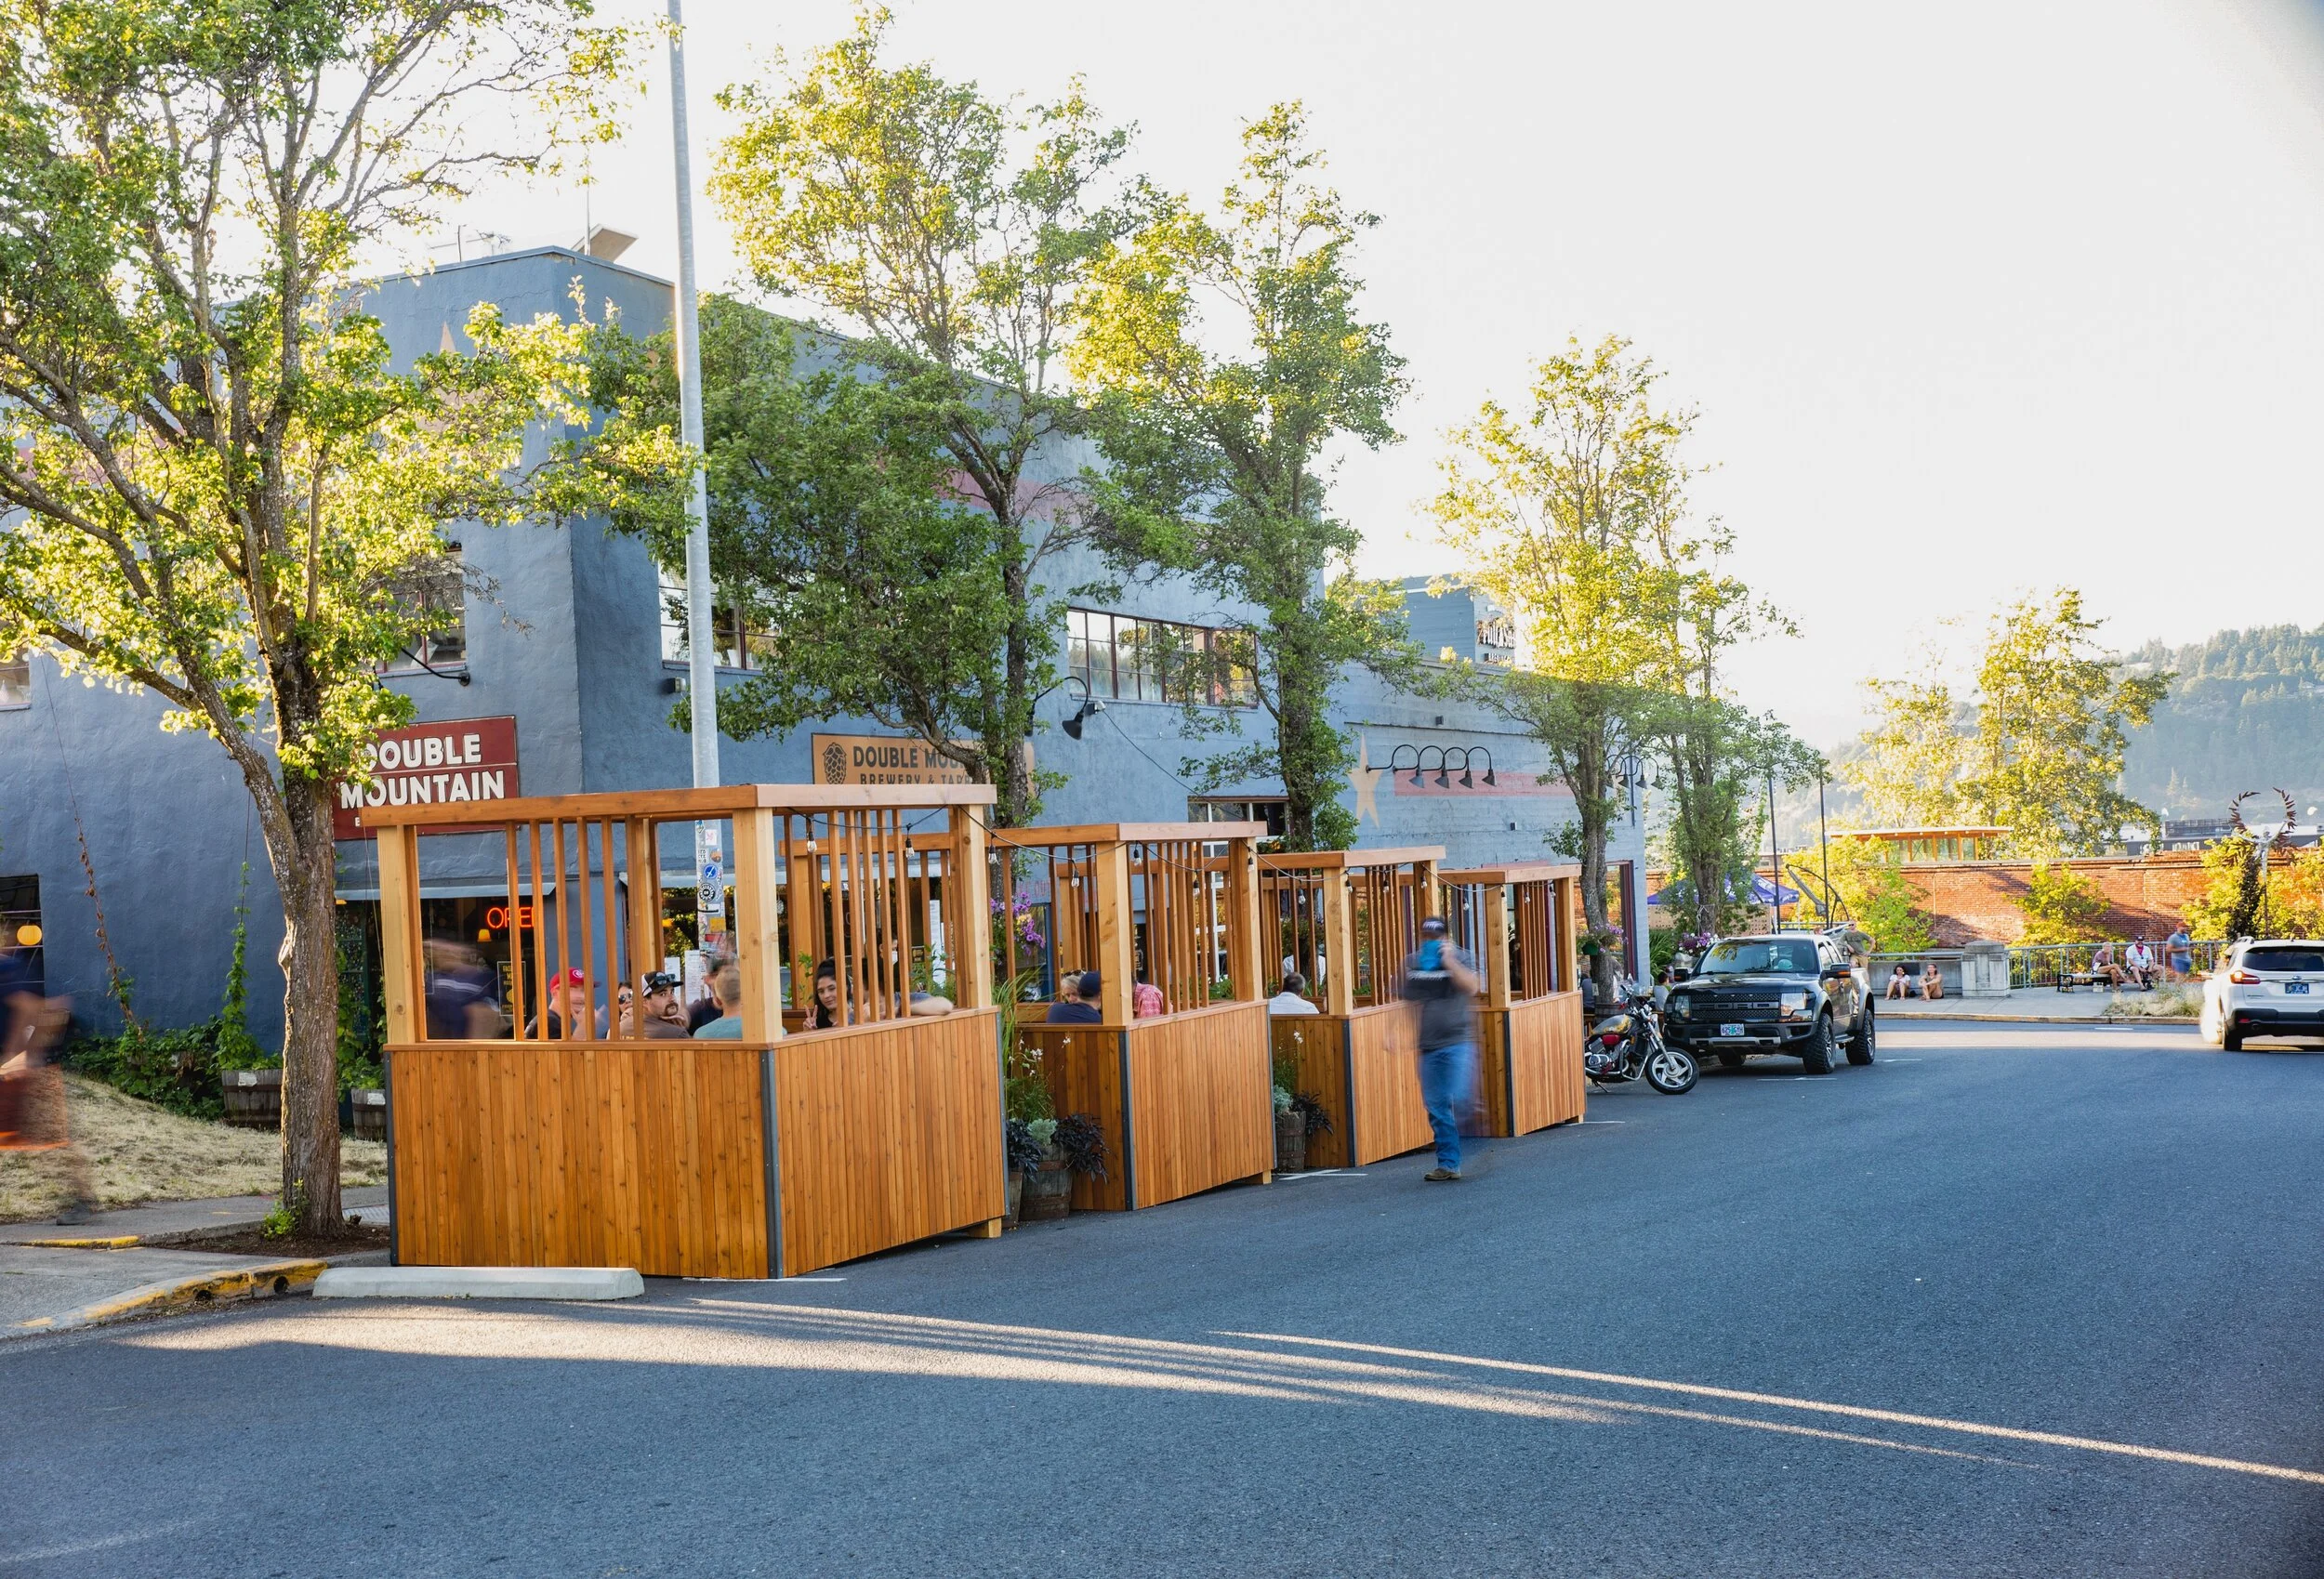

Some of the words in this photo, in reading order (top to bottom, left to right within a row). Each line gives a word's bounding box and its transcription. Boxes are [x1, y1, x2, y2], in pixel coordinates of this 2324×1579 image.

[363, 733, 482, 772] DOUBLE
[852, 745, 918, 769] DOUBLE
[340, 770, 505, 809] MOUNTAIN
[860, 773, 920, 784] BREWERY
